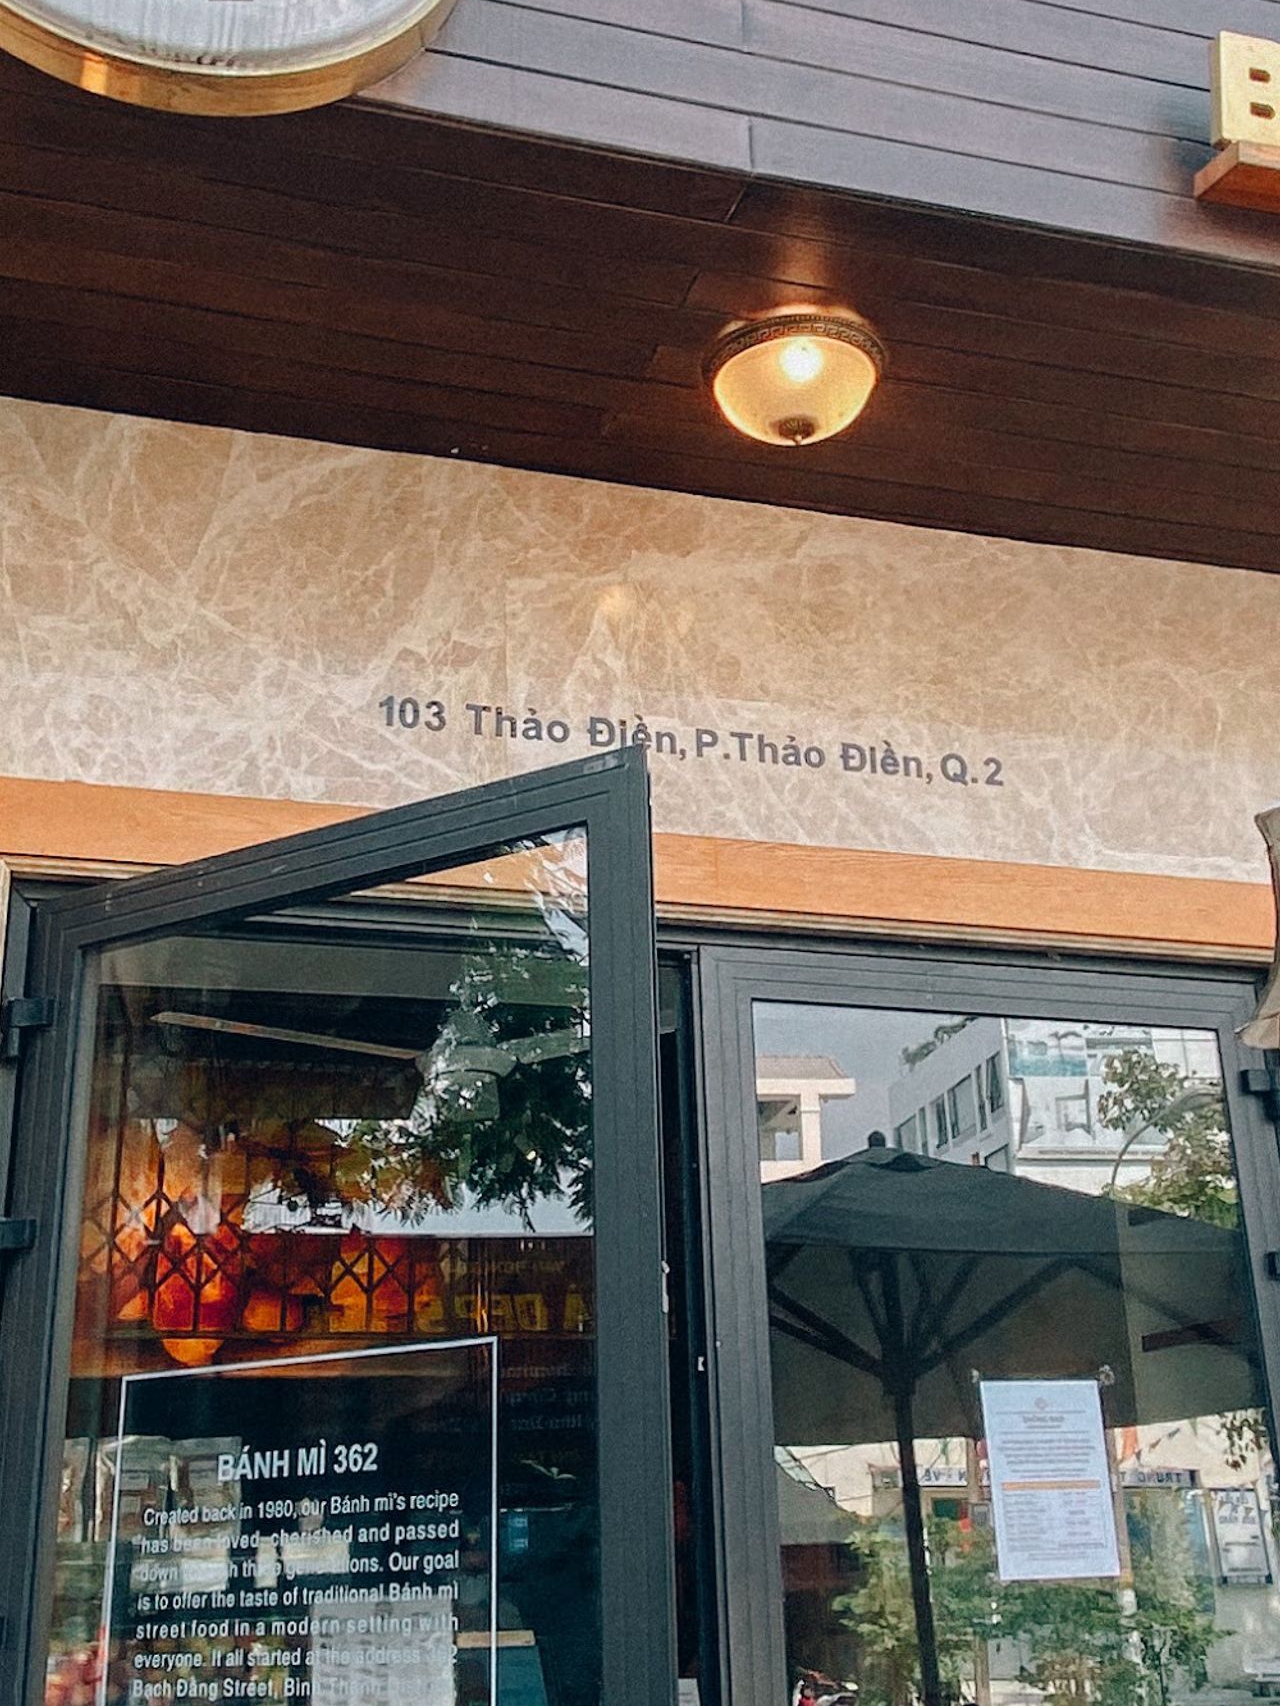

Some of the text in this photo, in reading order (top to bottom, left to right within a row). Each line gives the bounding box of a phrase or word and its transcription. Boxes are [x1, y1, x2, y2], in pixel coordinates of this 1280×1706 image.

[379, 695, 446, 732] 103
[466, 703, 570, 744] Thảo
[217, 1439, 378, 1482] BÁNH MÌ 362
[144, 1506, 198, 1526] Created
[201, 1503, 236, 1522] back
[240, 1502, 253, 1519] in
[257, 1499, 298, 1520] 1980,
[331, 1494, 369, 1515] Bánh
[409, 1490, 459, 1511] recipe
[141, 1536, 169, 1554] has
[358, 1523, 390, 1543] and
[395, 1520, 459, 1546] passed
[388, 1552, 418, 1572] Our
[423, 1550, 459, 1575] goal
[137, 1594, 150, 1611] is
[154, 1593, 168, 1610] to
[172, 1591, 207, 1609] offer
[211, 1590, 235, 1608] the
[240, 1588, 278, 1607] taste
[283, 1585, 299, 1606] of
[302, 1583, 384, 1605] traditional
[389, 1581, 433, 1602] Bánh
[136, 1613, 458, 1639] street food in a modern setting with
[225, 1648, 244, 1667] all
[247, 1646, 301, 1667] started
[223, 1677, 278, 1700] Street,
